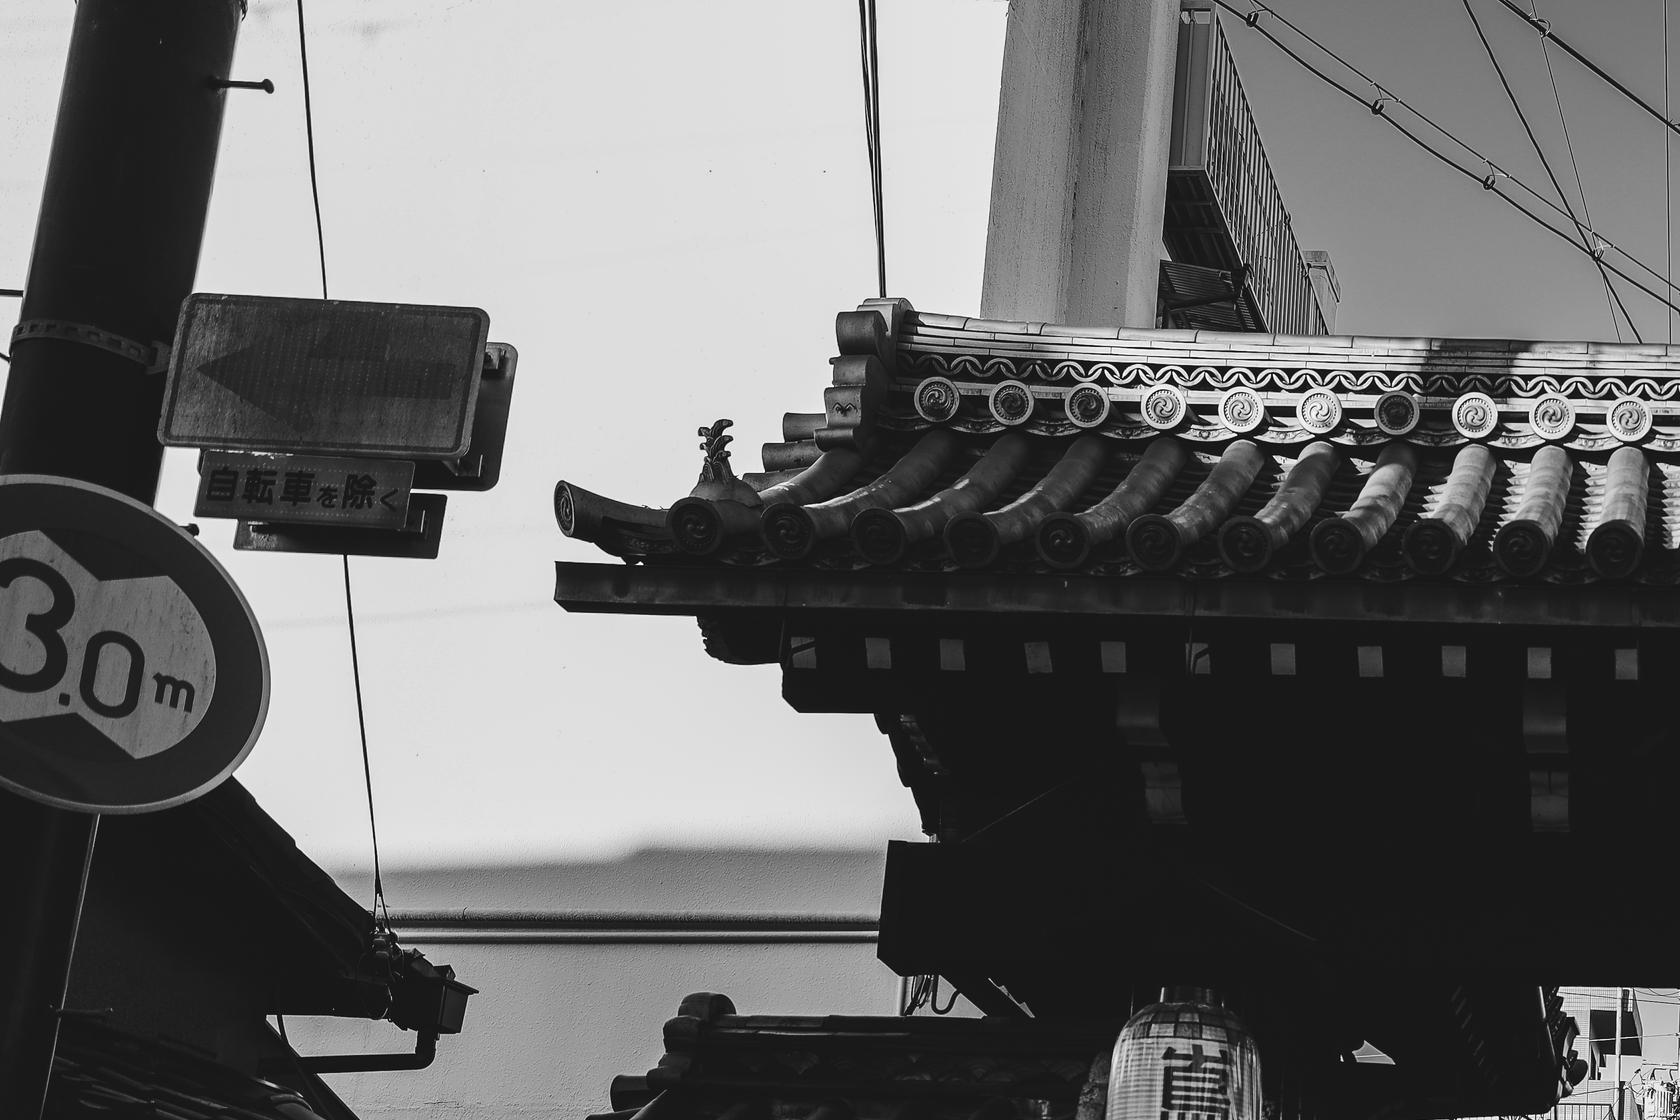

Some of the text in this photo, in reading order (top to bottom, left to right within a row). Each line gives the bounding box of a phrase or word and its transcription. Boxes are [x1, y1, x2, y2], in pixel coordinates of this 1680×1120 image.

[206, 466, 399, 512] 自転車を除く
